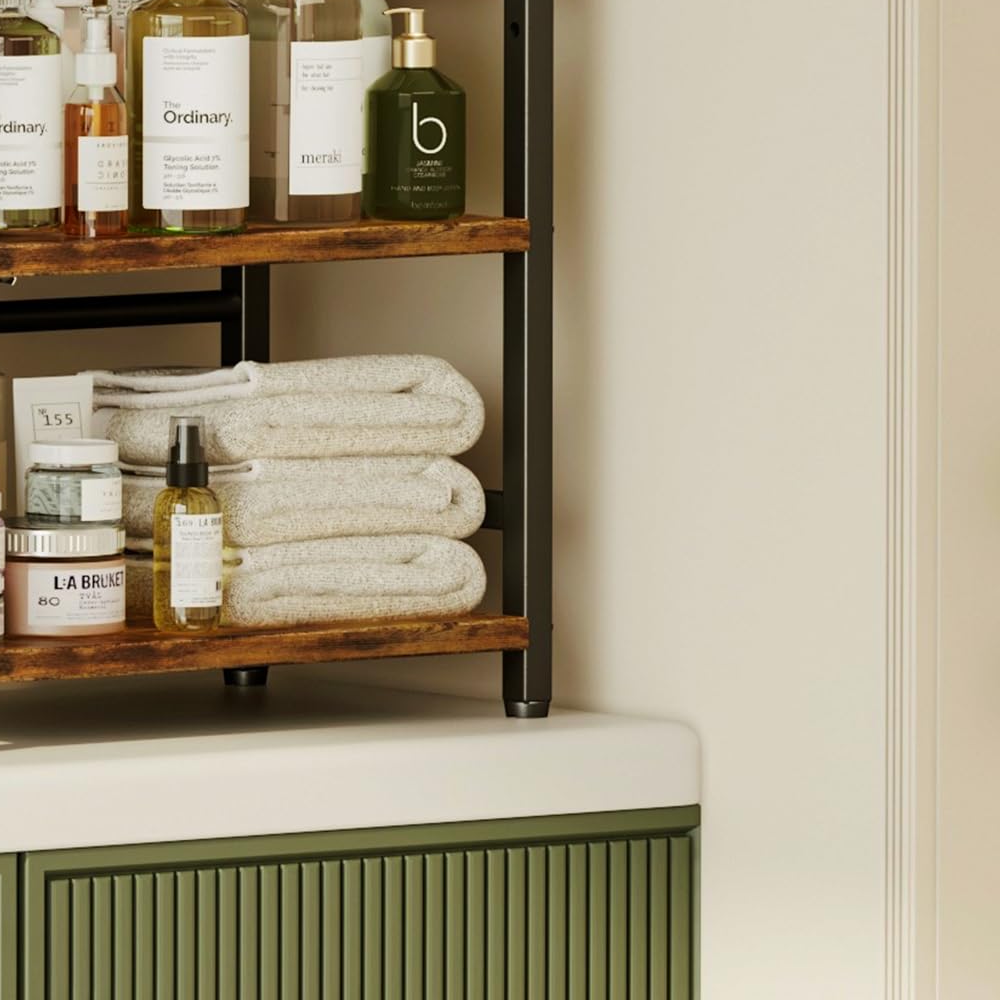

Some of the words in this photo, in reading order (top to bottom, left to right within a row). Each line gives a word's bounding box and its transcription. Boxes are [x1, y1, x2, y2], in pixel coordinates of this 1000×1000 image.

[163, 100, 181, 109] The
[413, 102, 447, 154] b
[301, 149, 342, 164] meraki
[44, 413, 73, 426] 155
[81, 570, 124, 590] BRUKET
